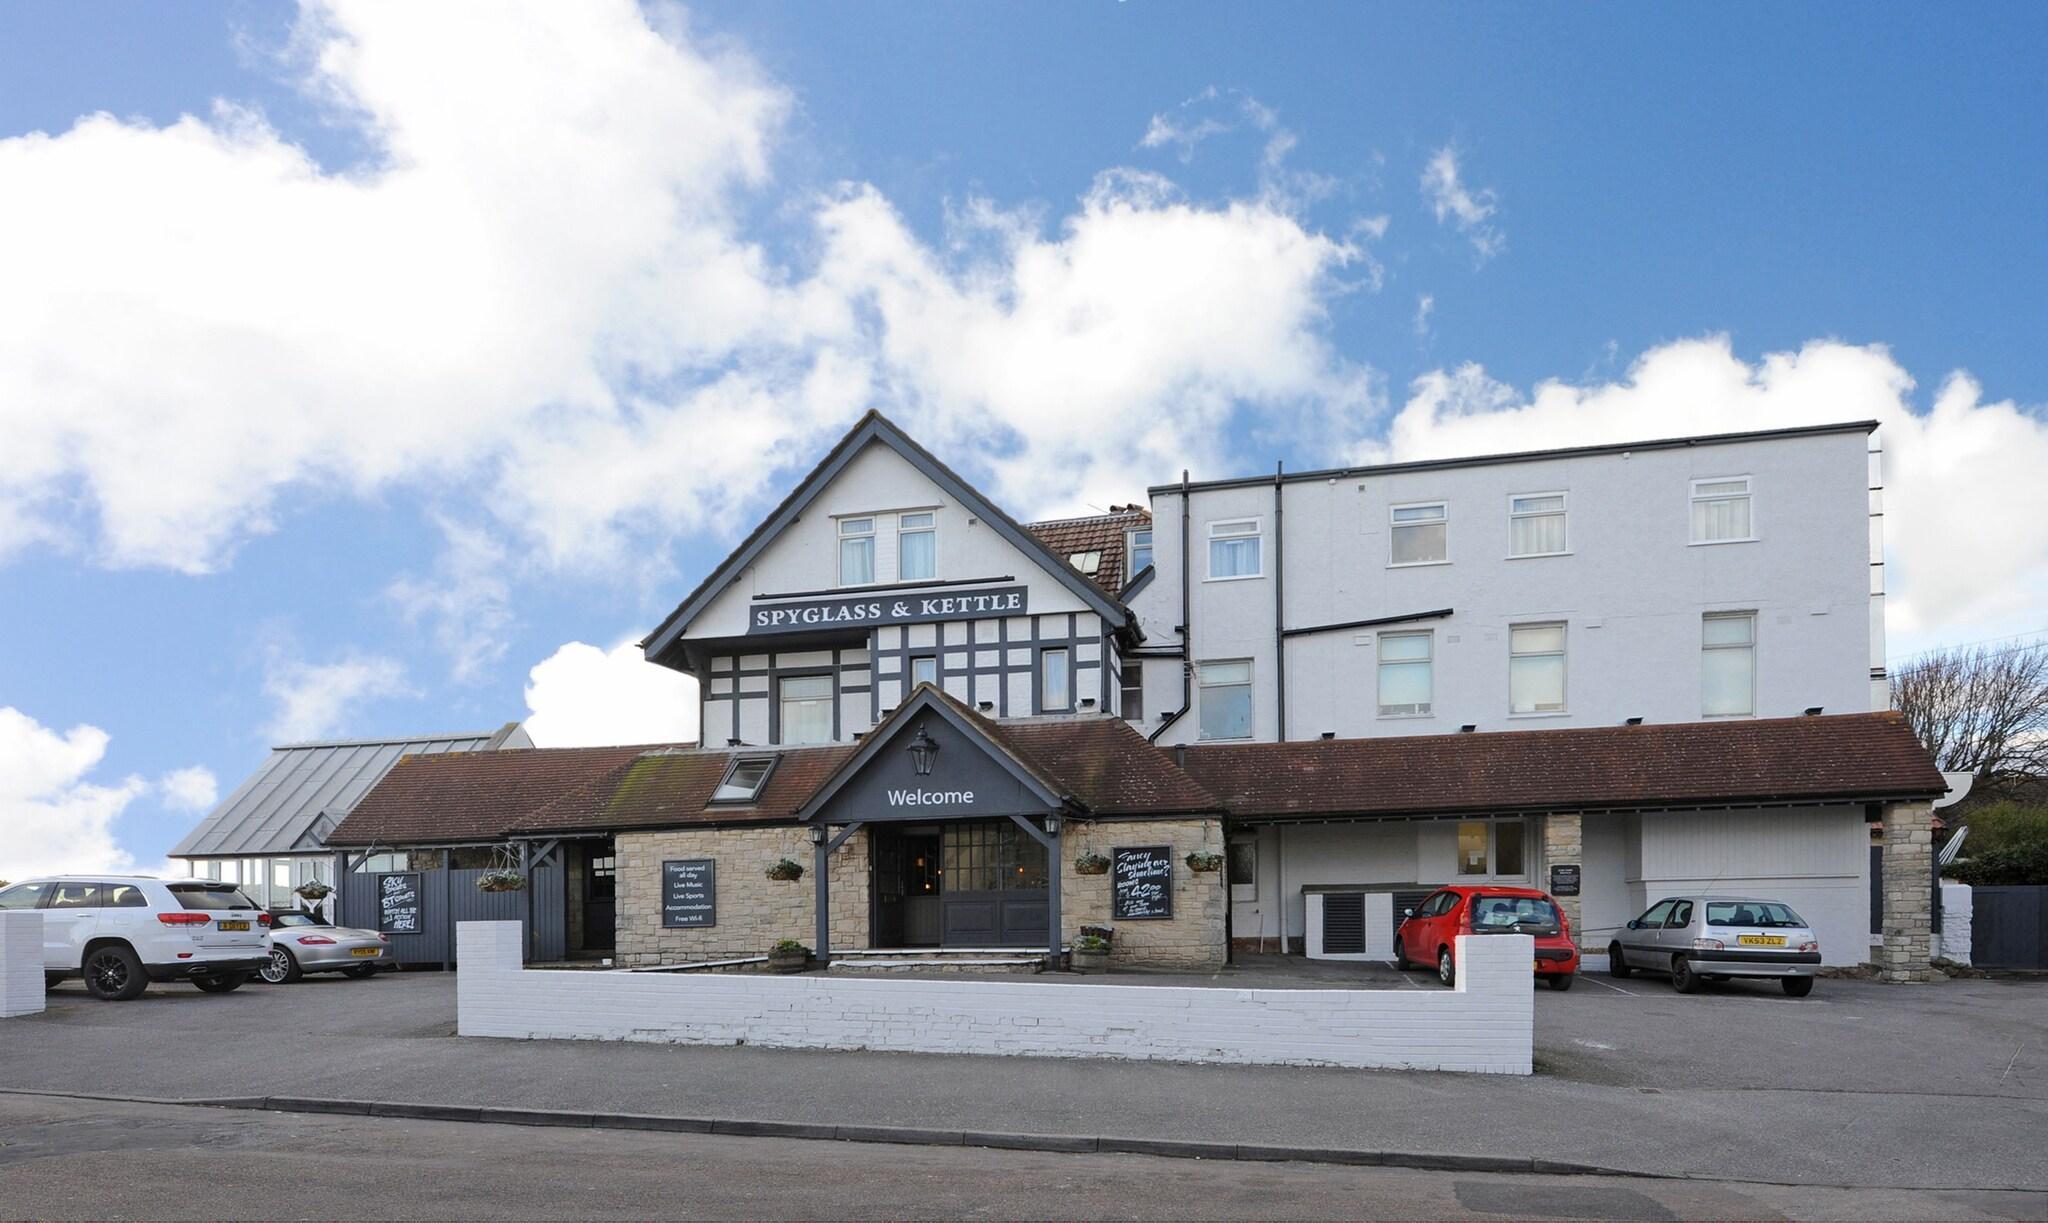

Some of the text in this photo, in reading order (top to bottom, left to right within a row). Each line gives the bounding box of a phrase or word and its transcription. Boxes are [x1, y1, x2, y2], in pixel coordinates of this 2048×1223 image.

[757, 593, 1021, 626] SPYGLASS & KETTLE
[887, 788, 974, 806] Welcome
[687, 872, 698, 880] day
[672, 892, 705, 900] Live Sports
[665, 903, 713, 911] Accommodation
